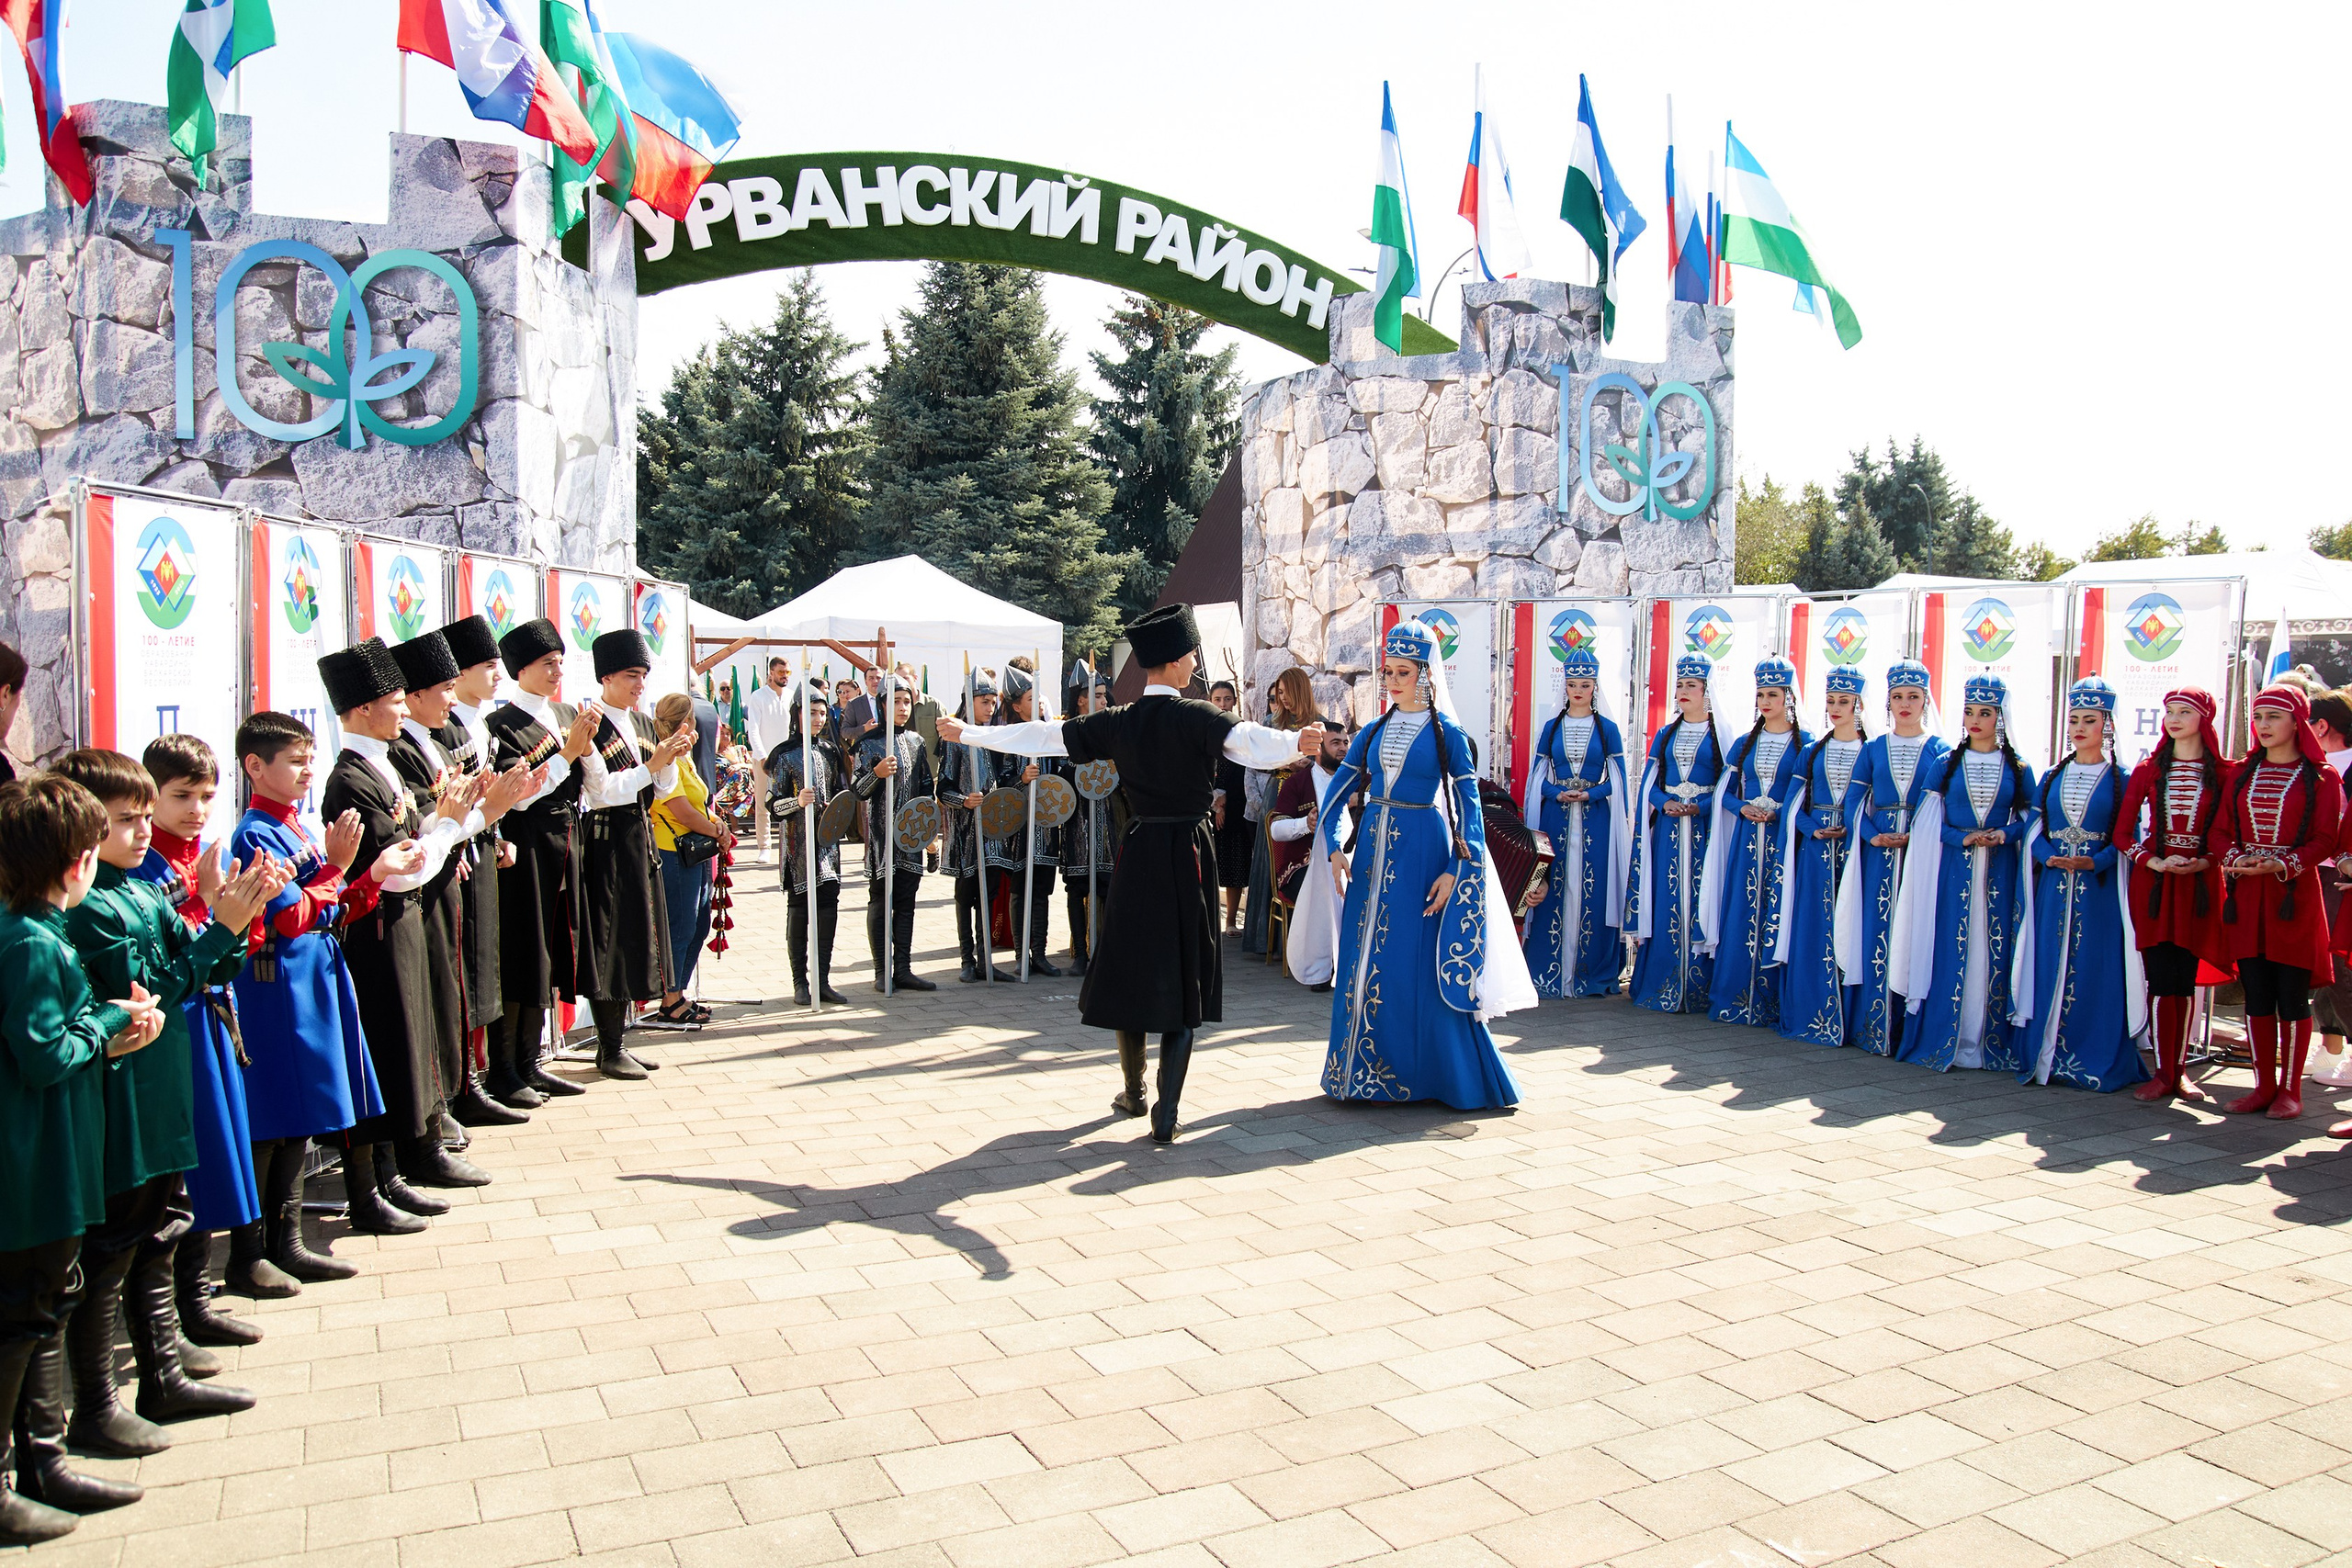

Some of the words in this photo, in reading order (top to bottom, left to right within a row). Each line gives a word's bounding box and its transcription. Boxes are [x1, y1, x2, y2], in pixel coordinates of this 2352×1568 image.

[625, 164, 1102, 262] УРВАНСКИЙ
[1114, 197, 1335, 330] РАЙОН
[154, 228, 479, 450] 100
[1550, 364, 1715, 523] 100
[141, 635, 159, 646] 100
[168, 636, 195, 647] ЛЕТИЕ
